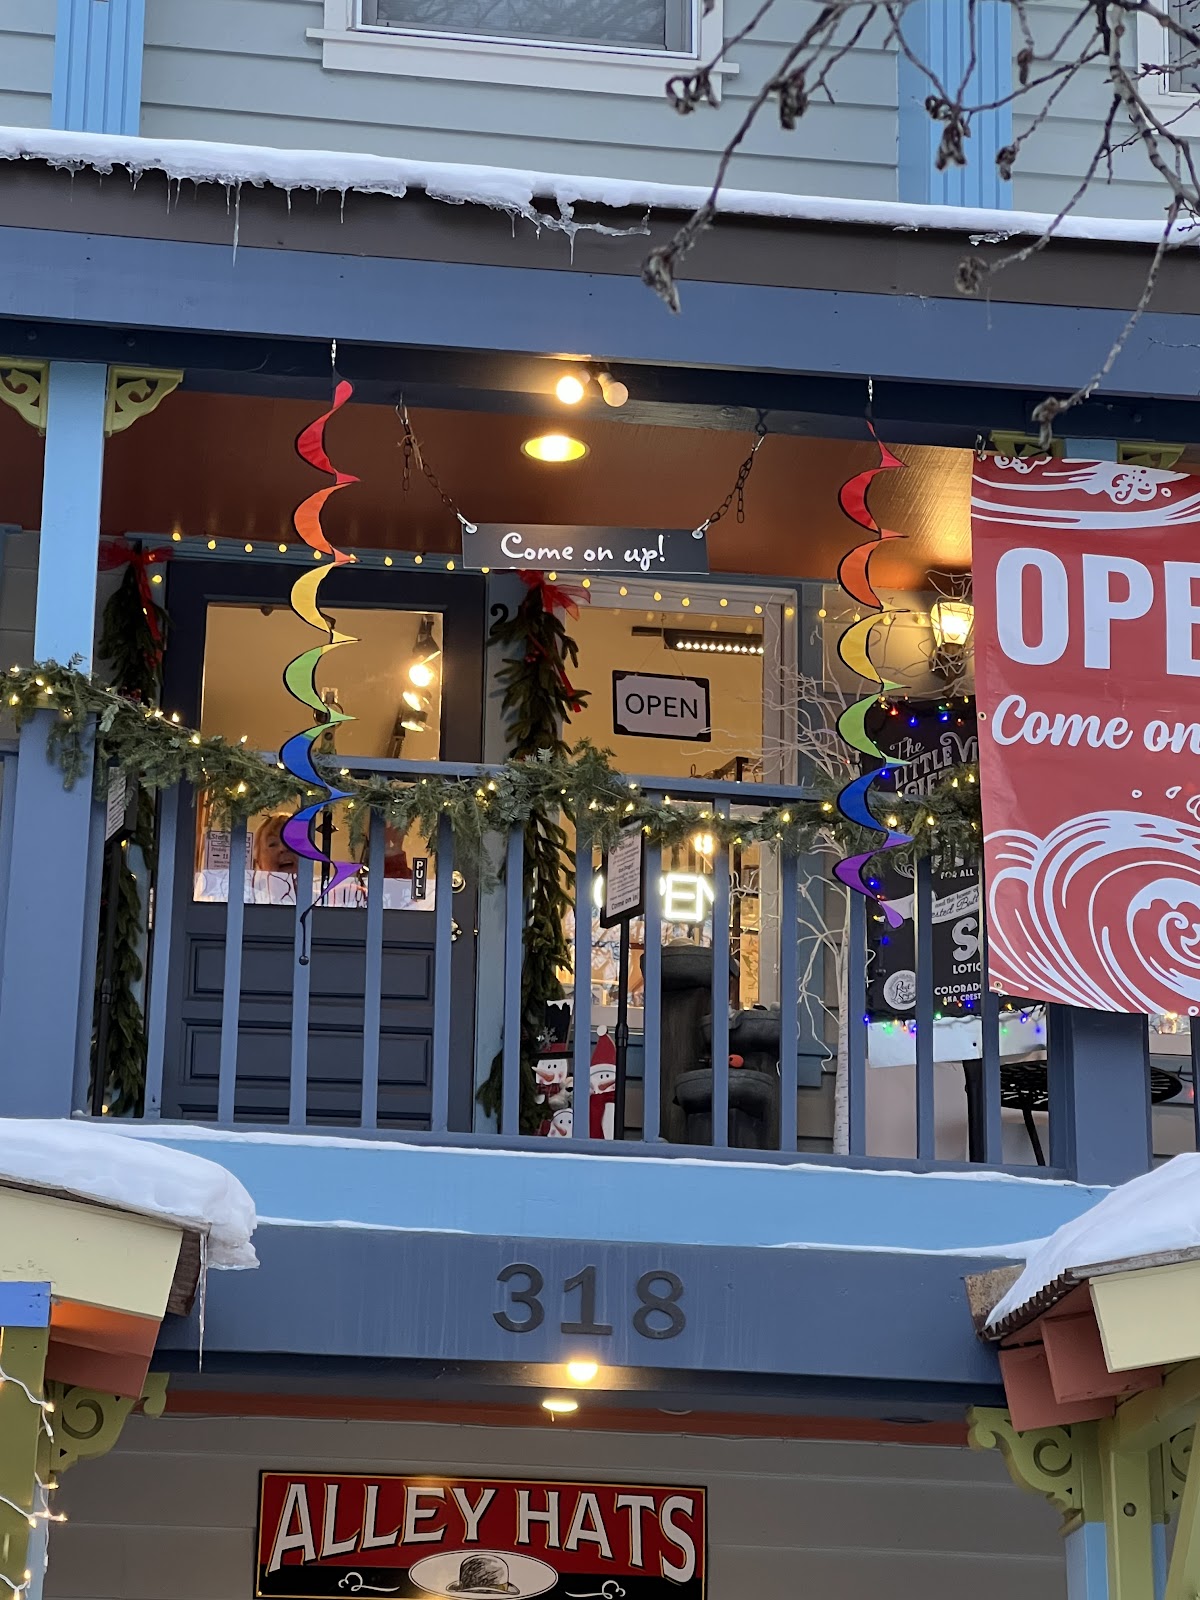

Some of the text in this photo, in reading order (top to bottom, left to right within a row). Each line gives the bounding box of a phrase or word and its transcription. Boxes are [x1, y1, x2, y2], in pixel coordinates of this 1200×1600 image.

[500, 532, 666, 571] Come on up!
[625, 693, 699, 719] OPEN
[991, 694, 1134, 750] Come
[889, 736, 925, 760] The
[894, 745, 953, 790] LITTLE
[904, 767, 955, 796] GIF
[415, 860, 424, 897] PULL
[960, 868, 974, 878] ALL
[934, 983, 982, 995] COLORAD
[492, 1262, 687, 1340] 318
[264, 1481, 699, 1584] ALLEY HATS
